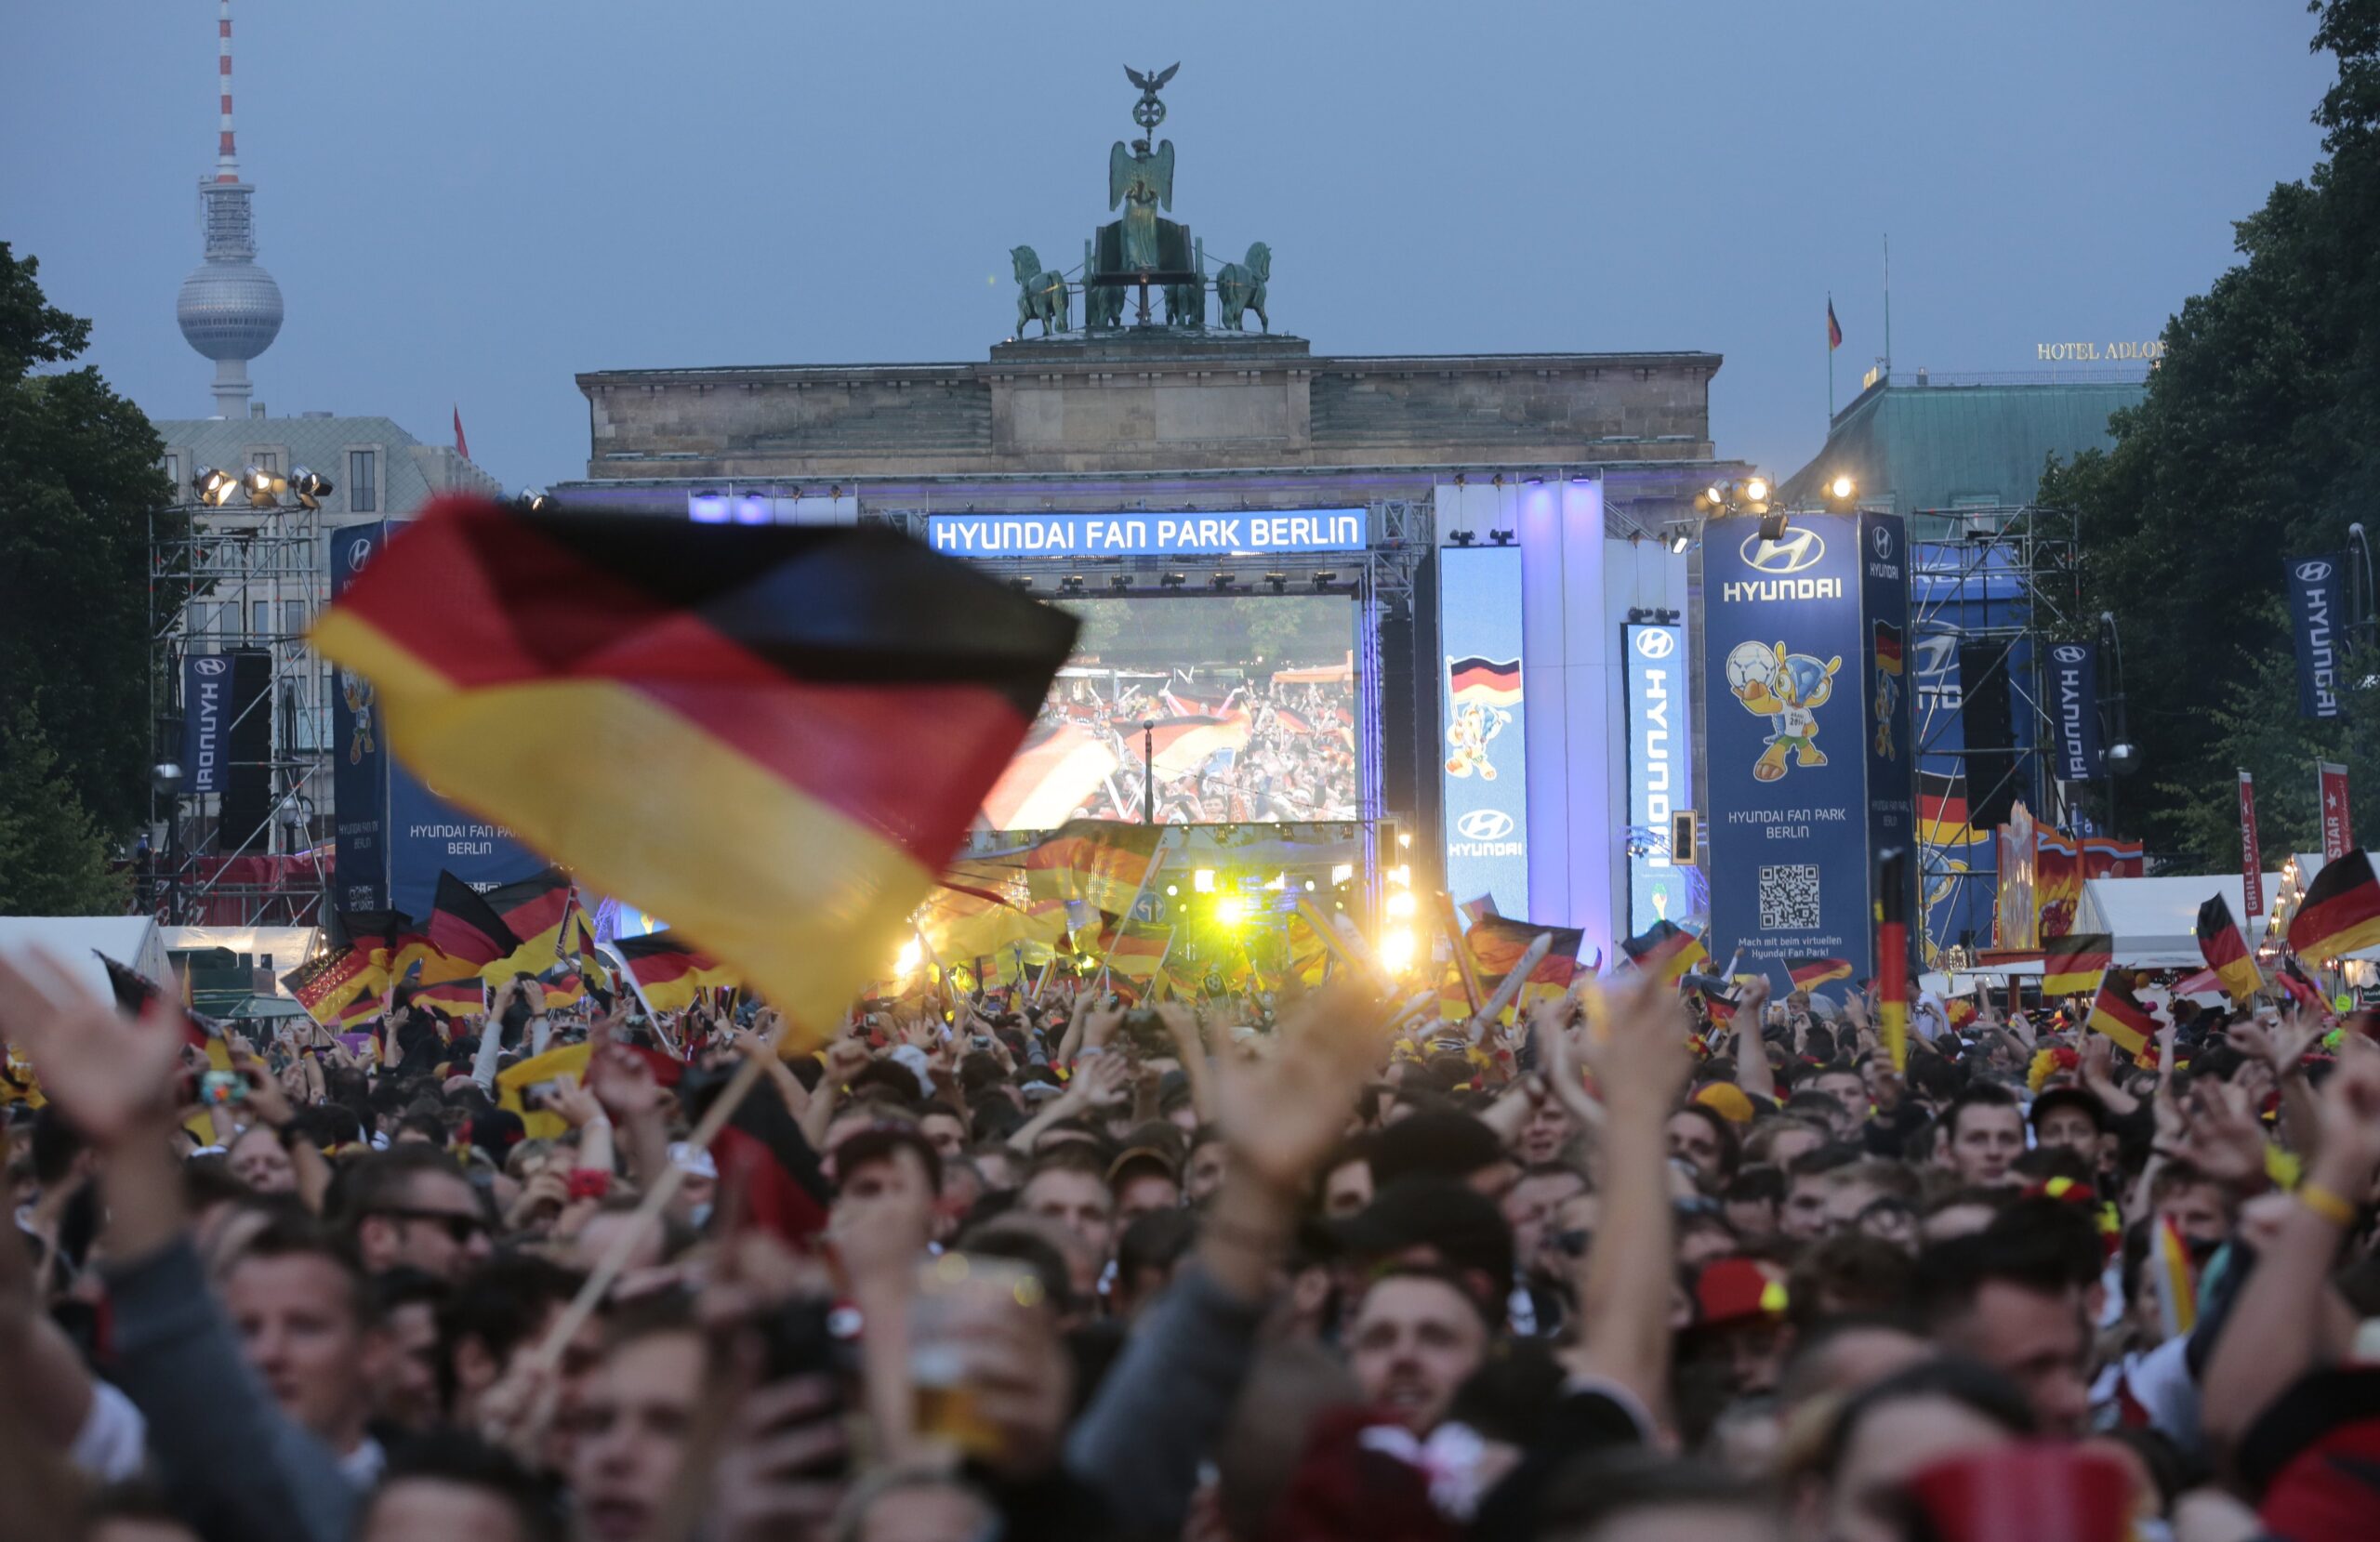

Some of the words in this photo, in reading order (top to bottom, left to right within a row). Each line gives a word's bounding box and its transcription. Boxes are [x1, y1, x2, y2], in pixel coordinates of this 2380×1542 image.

[2038, 342, 2100, 361] HOTEL
[937, 521, 1075, 550] HYUNDAI
[1086, 521, 1146, 548] FAN
[1157, 519, 1240, 548] PARK
[1250, 516, 1358, 547] BERLIN
[1871, 561, 1899, 580] HYUNDAI
[1723, 577, 1842, 602] HYUNDAI
[2306, 588, 2337, 717] HYUNDAI
[2061, 669, 2089, 779] HYUNDAI
[196, 683, 218, 791] HYUNDAI
[1728, 810, 1783, 824] HYUNDAI
[1787, 809, 1811, 822] FAN
[1815, 808, 1846, 821] PARK
[410, 824, 466, 837] HYUNDAI
[469, 824, 493, 837] FAN
[1766, 825, 1809, 838] BERLIN
[2327, 816, 2343, 860] STAR
[447, 842, 492, 854] BERLIN
[1448, 841, 1523, 857] HYUNDAI
[2241, 823, 2253, 862] STAR
[2246, 870, 2257, 911] GRILL
[1739, 937, 1762, 946] Mach
[1765, 936, 1778, 945] mit
[1780, 936, 1800, 946] beim
[1802, 935, 1843, 945] virtuellen
[1752, 948, 1785, 959] Hyundai
[1788, 947, 1804, 956] Fan
